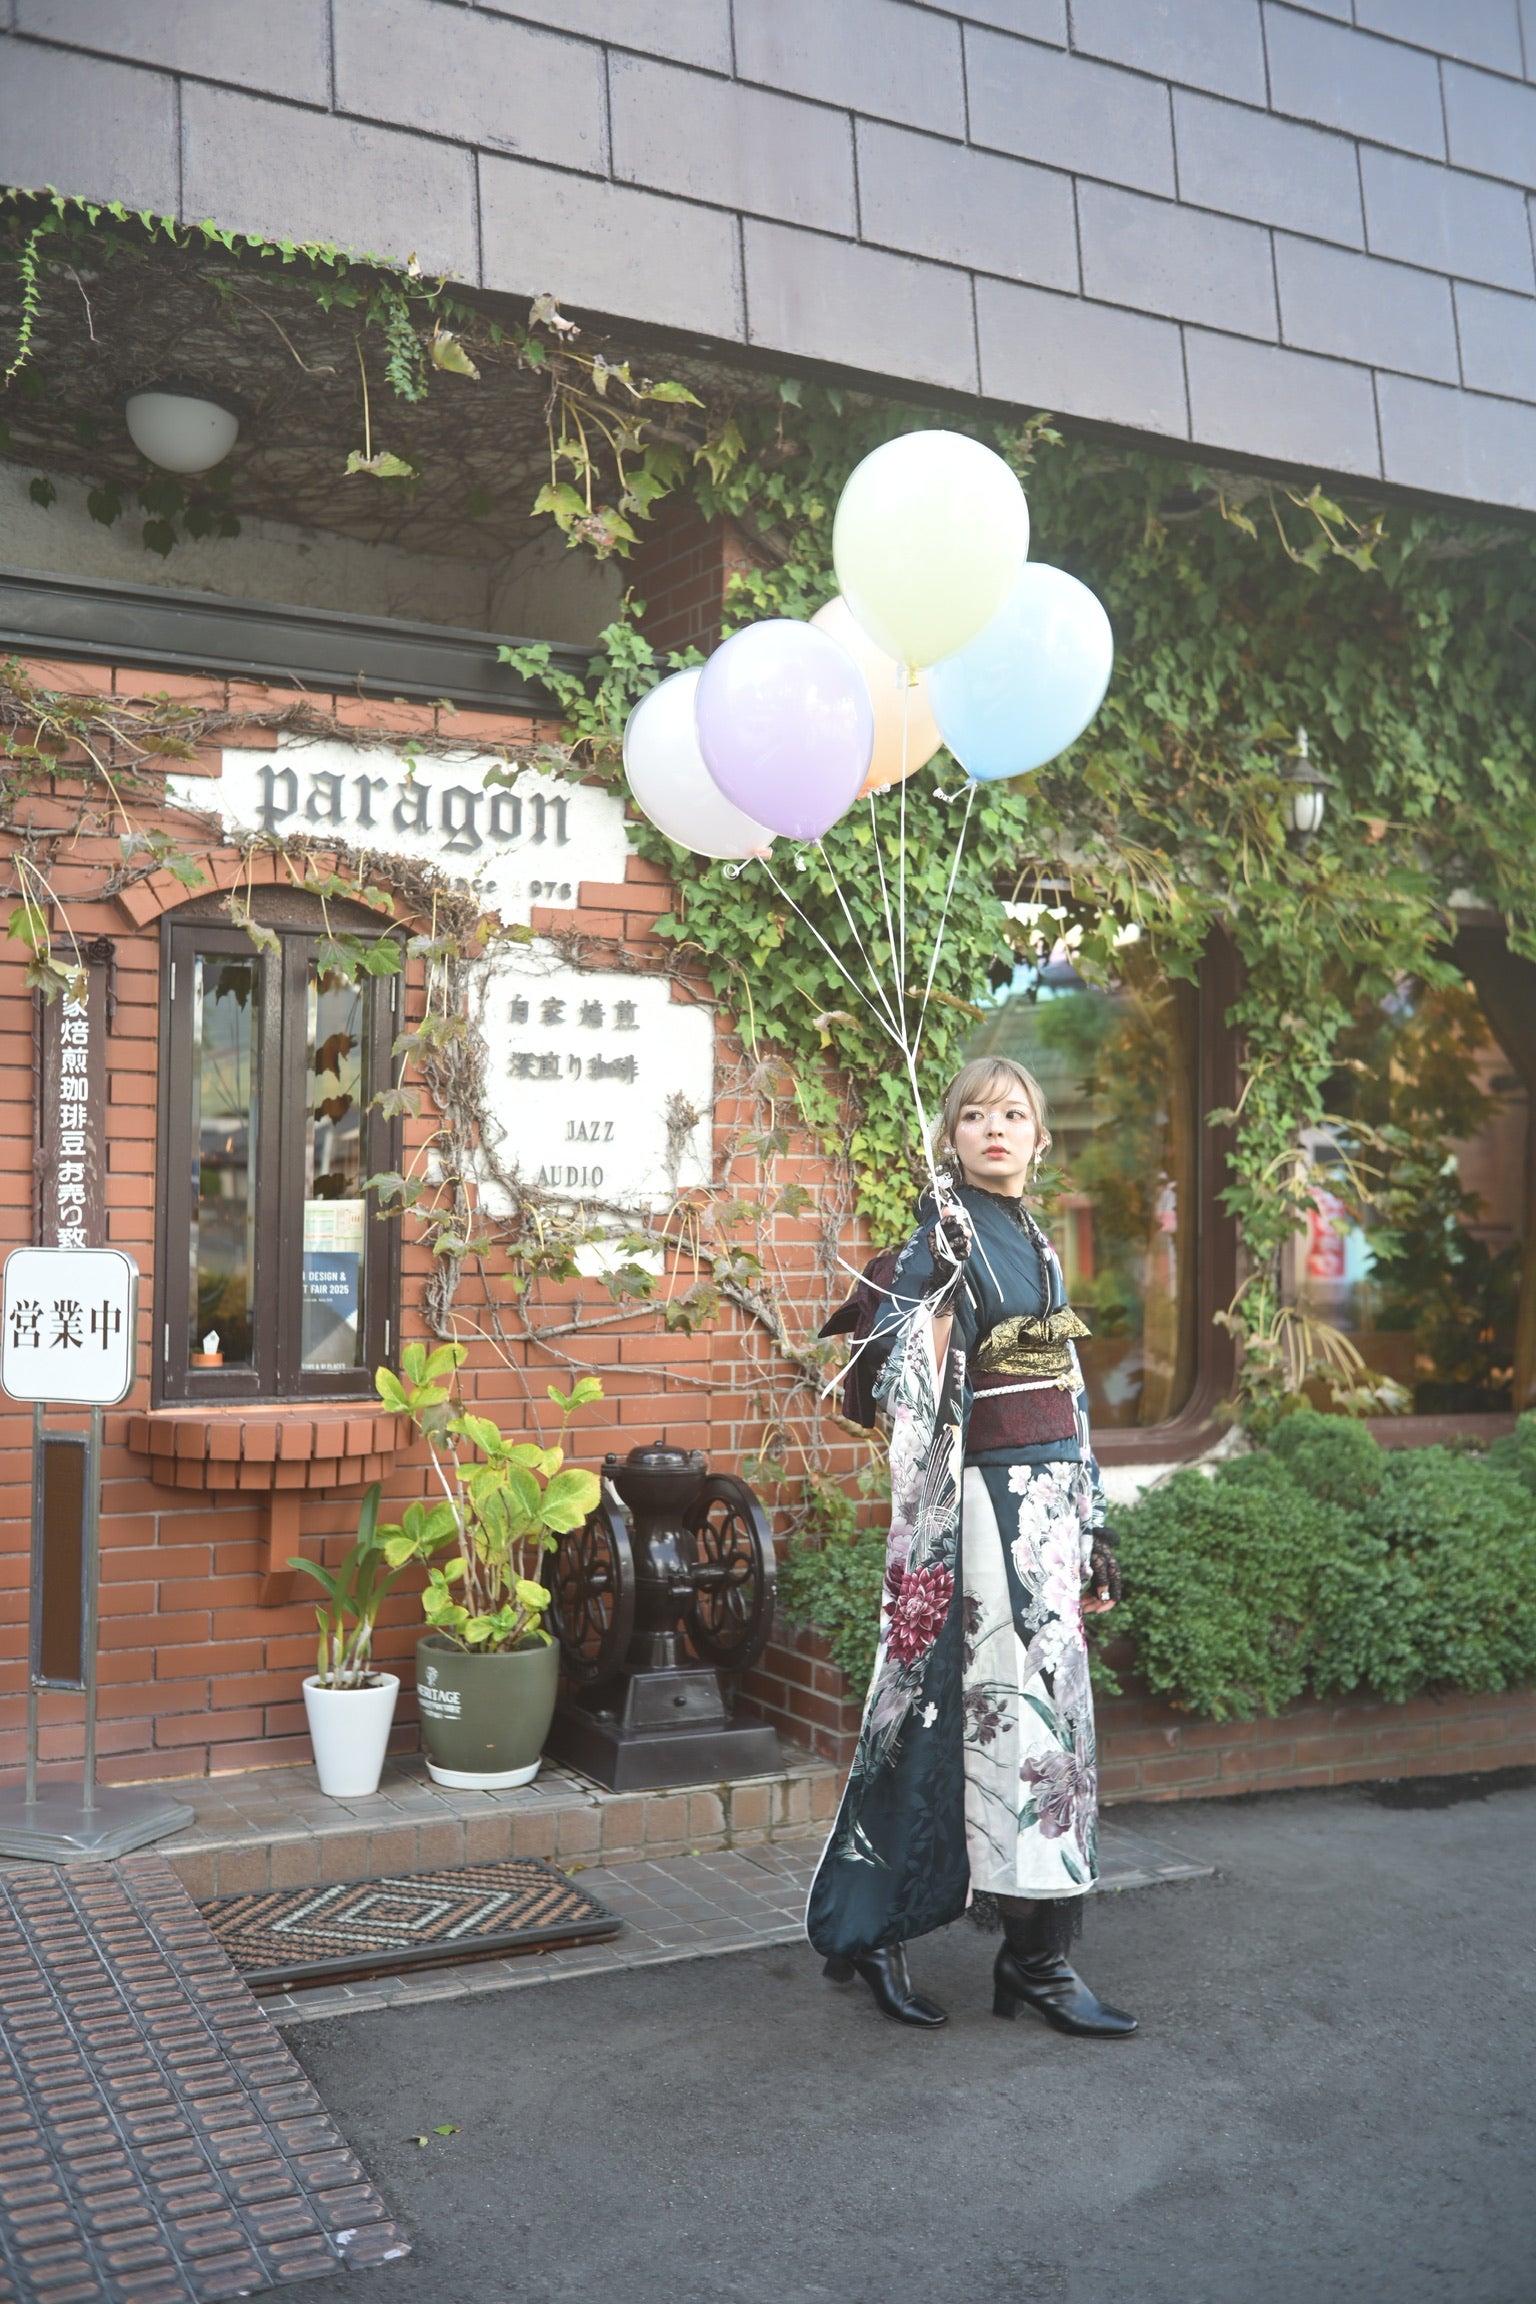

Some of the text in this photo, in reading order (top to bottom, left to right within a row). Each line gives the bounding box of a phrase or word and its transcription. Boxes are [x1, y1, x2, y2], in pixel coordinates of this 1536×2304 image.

[255, 763, 571, 853] paragon
[566, 1119, 615, 1142] JAZZ
[537, 1164, 605, 1188] AUDIO
[308, 1271, 338, 1281] DESIGN
[340, 1271, 347, 1281] &
[310, 1284, 328, 1294] FAIR
[329, 1284, 350, 1295] 2025
[9, 1299, 122, 1351] 営業中
